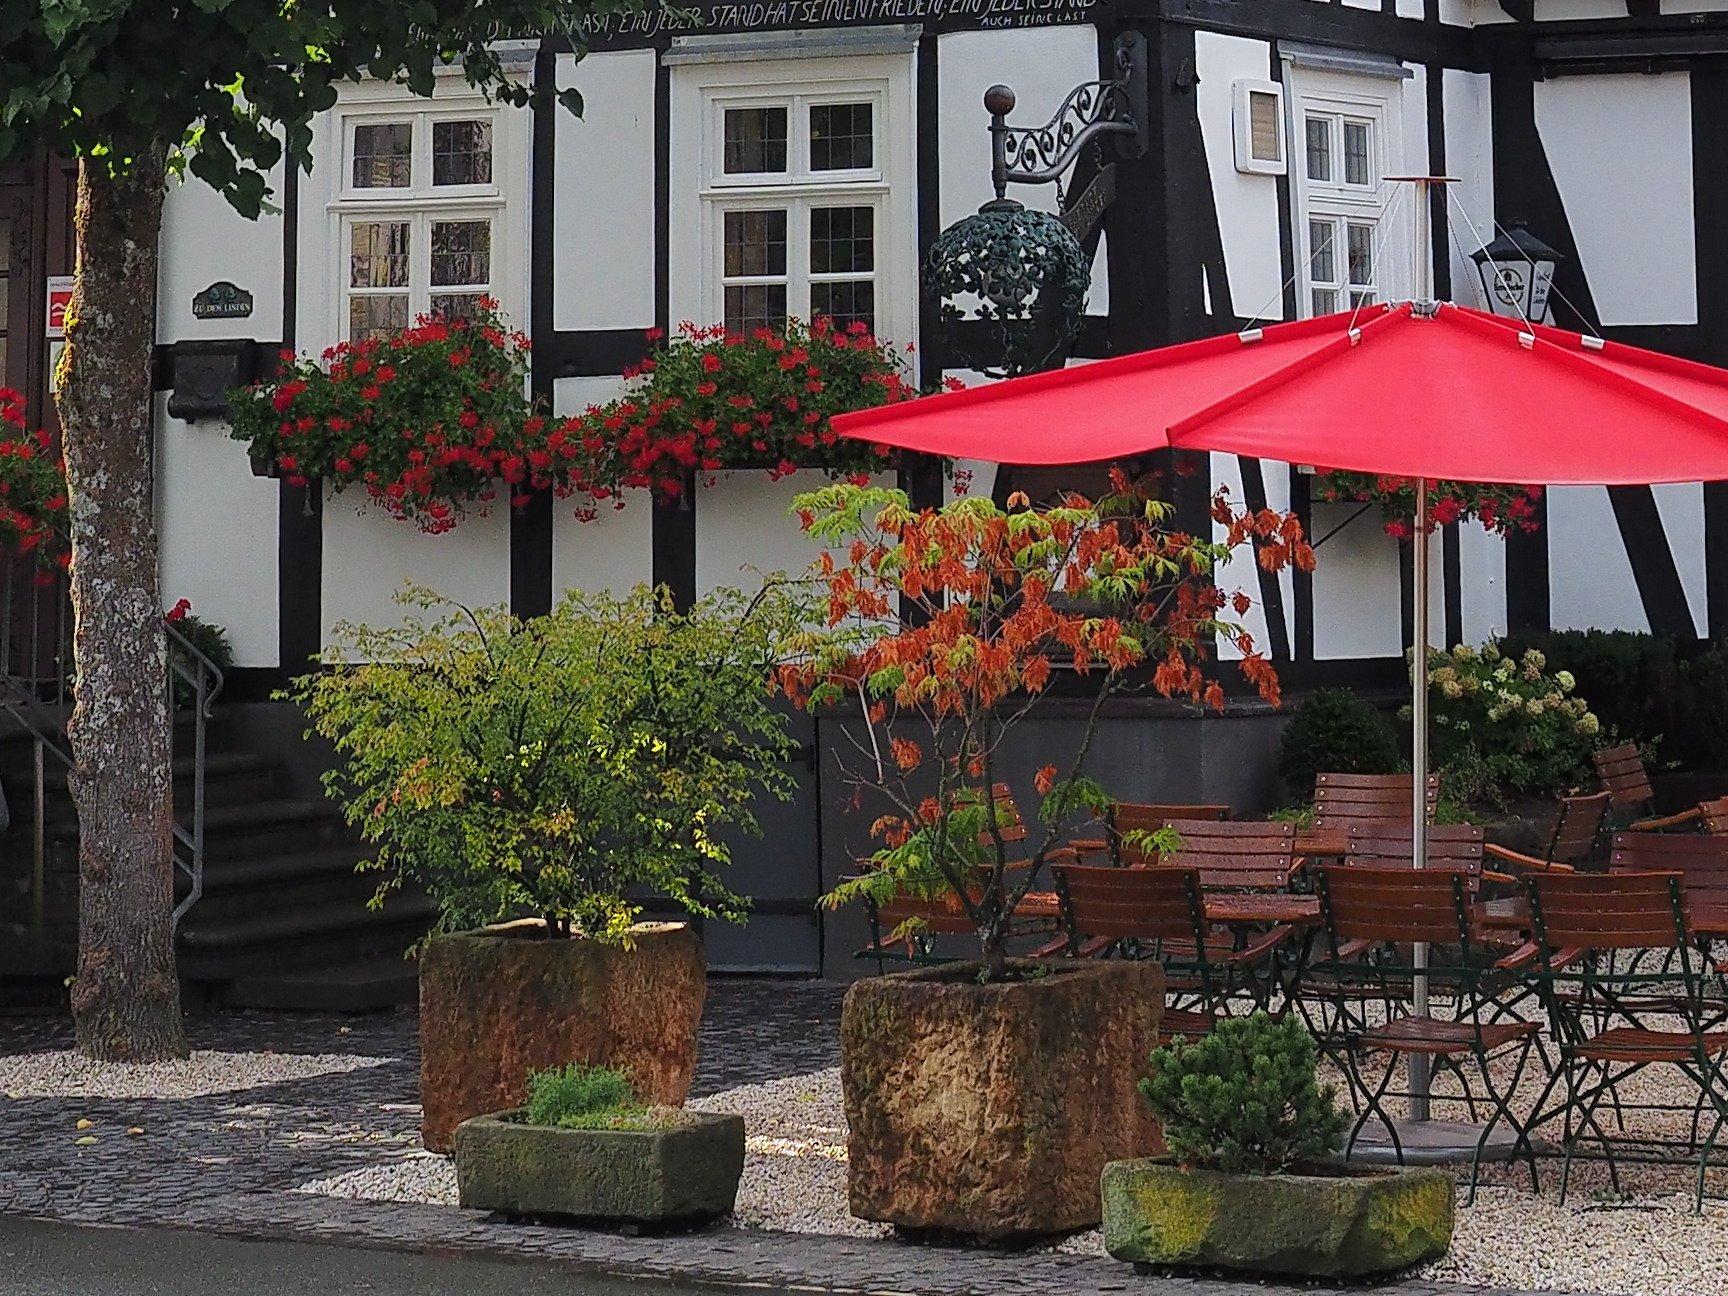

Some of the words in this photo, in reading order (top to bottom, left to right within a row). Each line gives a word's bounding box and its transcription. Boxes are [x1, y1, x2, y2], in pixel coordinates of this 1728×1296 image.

[707, 2, 765, 28] STAND
[764, 0, 801, 25] HAT
[981, 16, 1012, 26] AUCH
[1055, 11, 1086, 23] LAST
